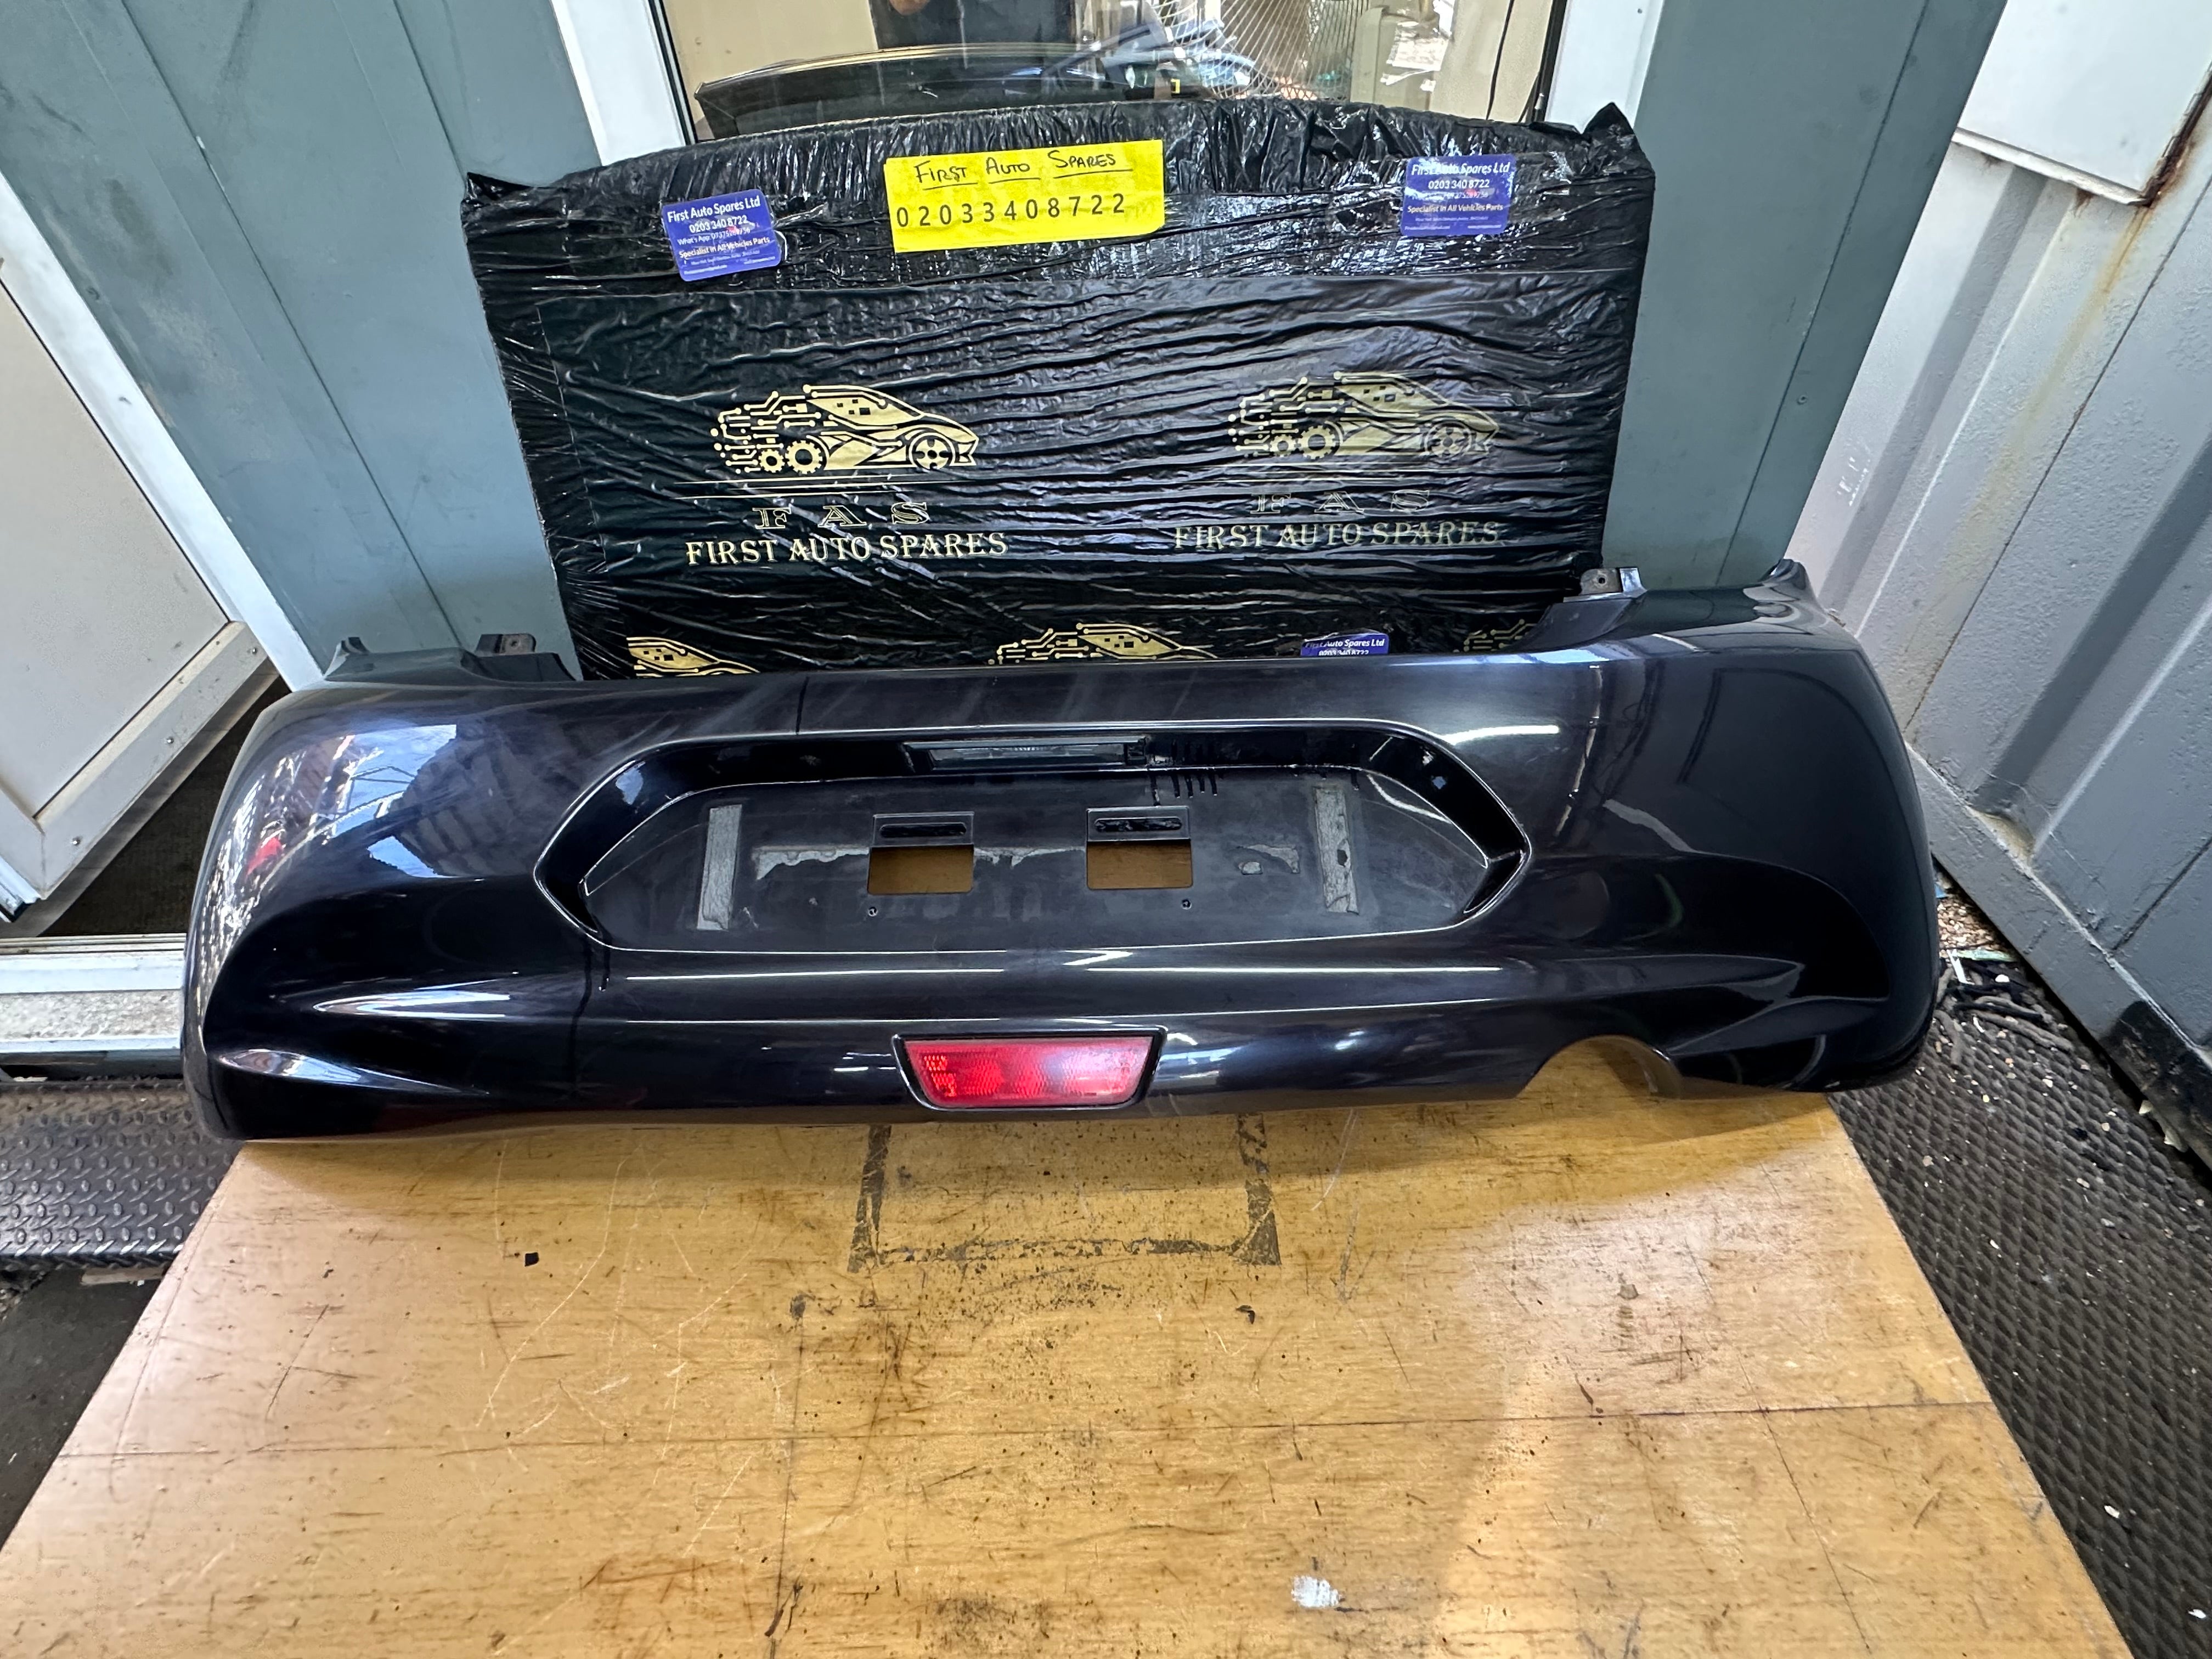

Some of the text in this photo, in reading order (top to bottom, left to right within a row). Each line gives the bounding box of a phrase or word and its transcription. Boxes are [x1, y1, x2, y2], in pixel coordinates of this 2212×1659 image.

[914, 150, 1116, 184] FIRST AUTO SPARES
[1460, 162, 1492, 176] Spares
[1493, 162, 1510, 173] Ltd
[1428, 179, 1490, 189] 0203 340 8722
[667, 195, 760, 223] First Auto Spares Ltd
[1407, 205, 1438, 213] Specialist
[689, 215, 748, 234] 0203 340 8722
[753, 236, 770, 245] Parts
[1173, 520, 1500, 550] FIRST AUTO SPARES
[685, 532, 1009, 566] FIRST AUTO SPARES
[1344, 639, 1370, 648] Spares
[1371, 638, 1385, 646] Ltd
